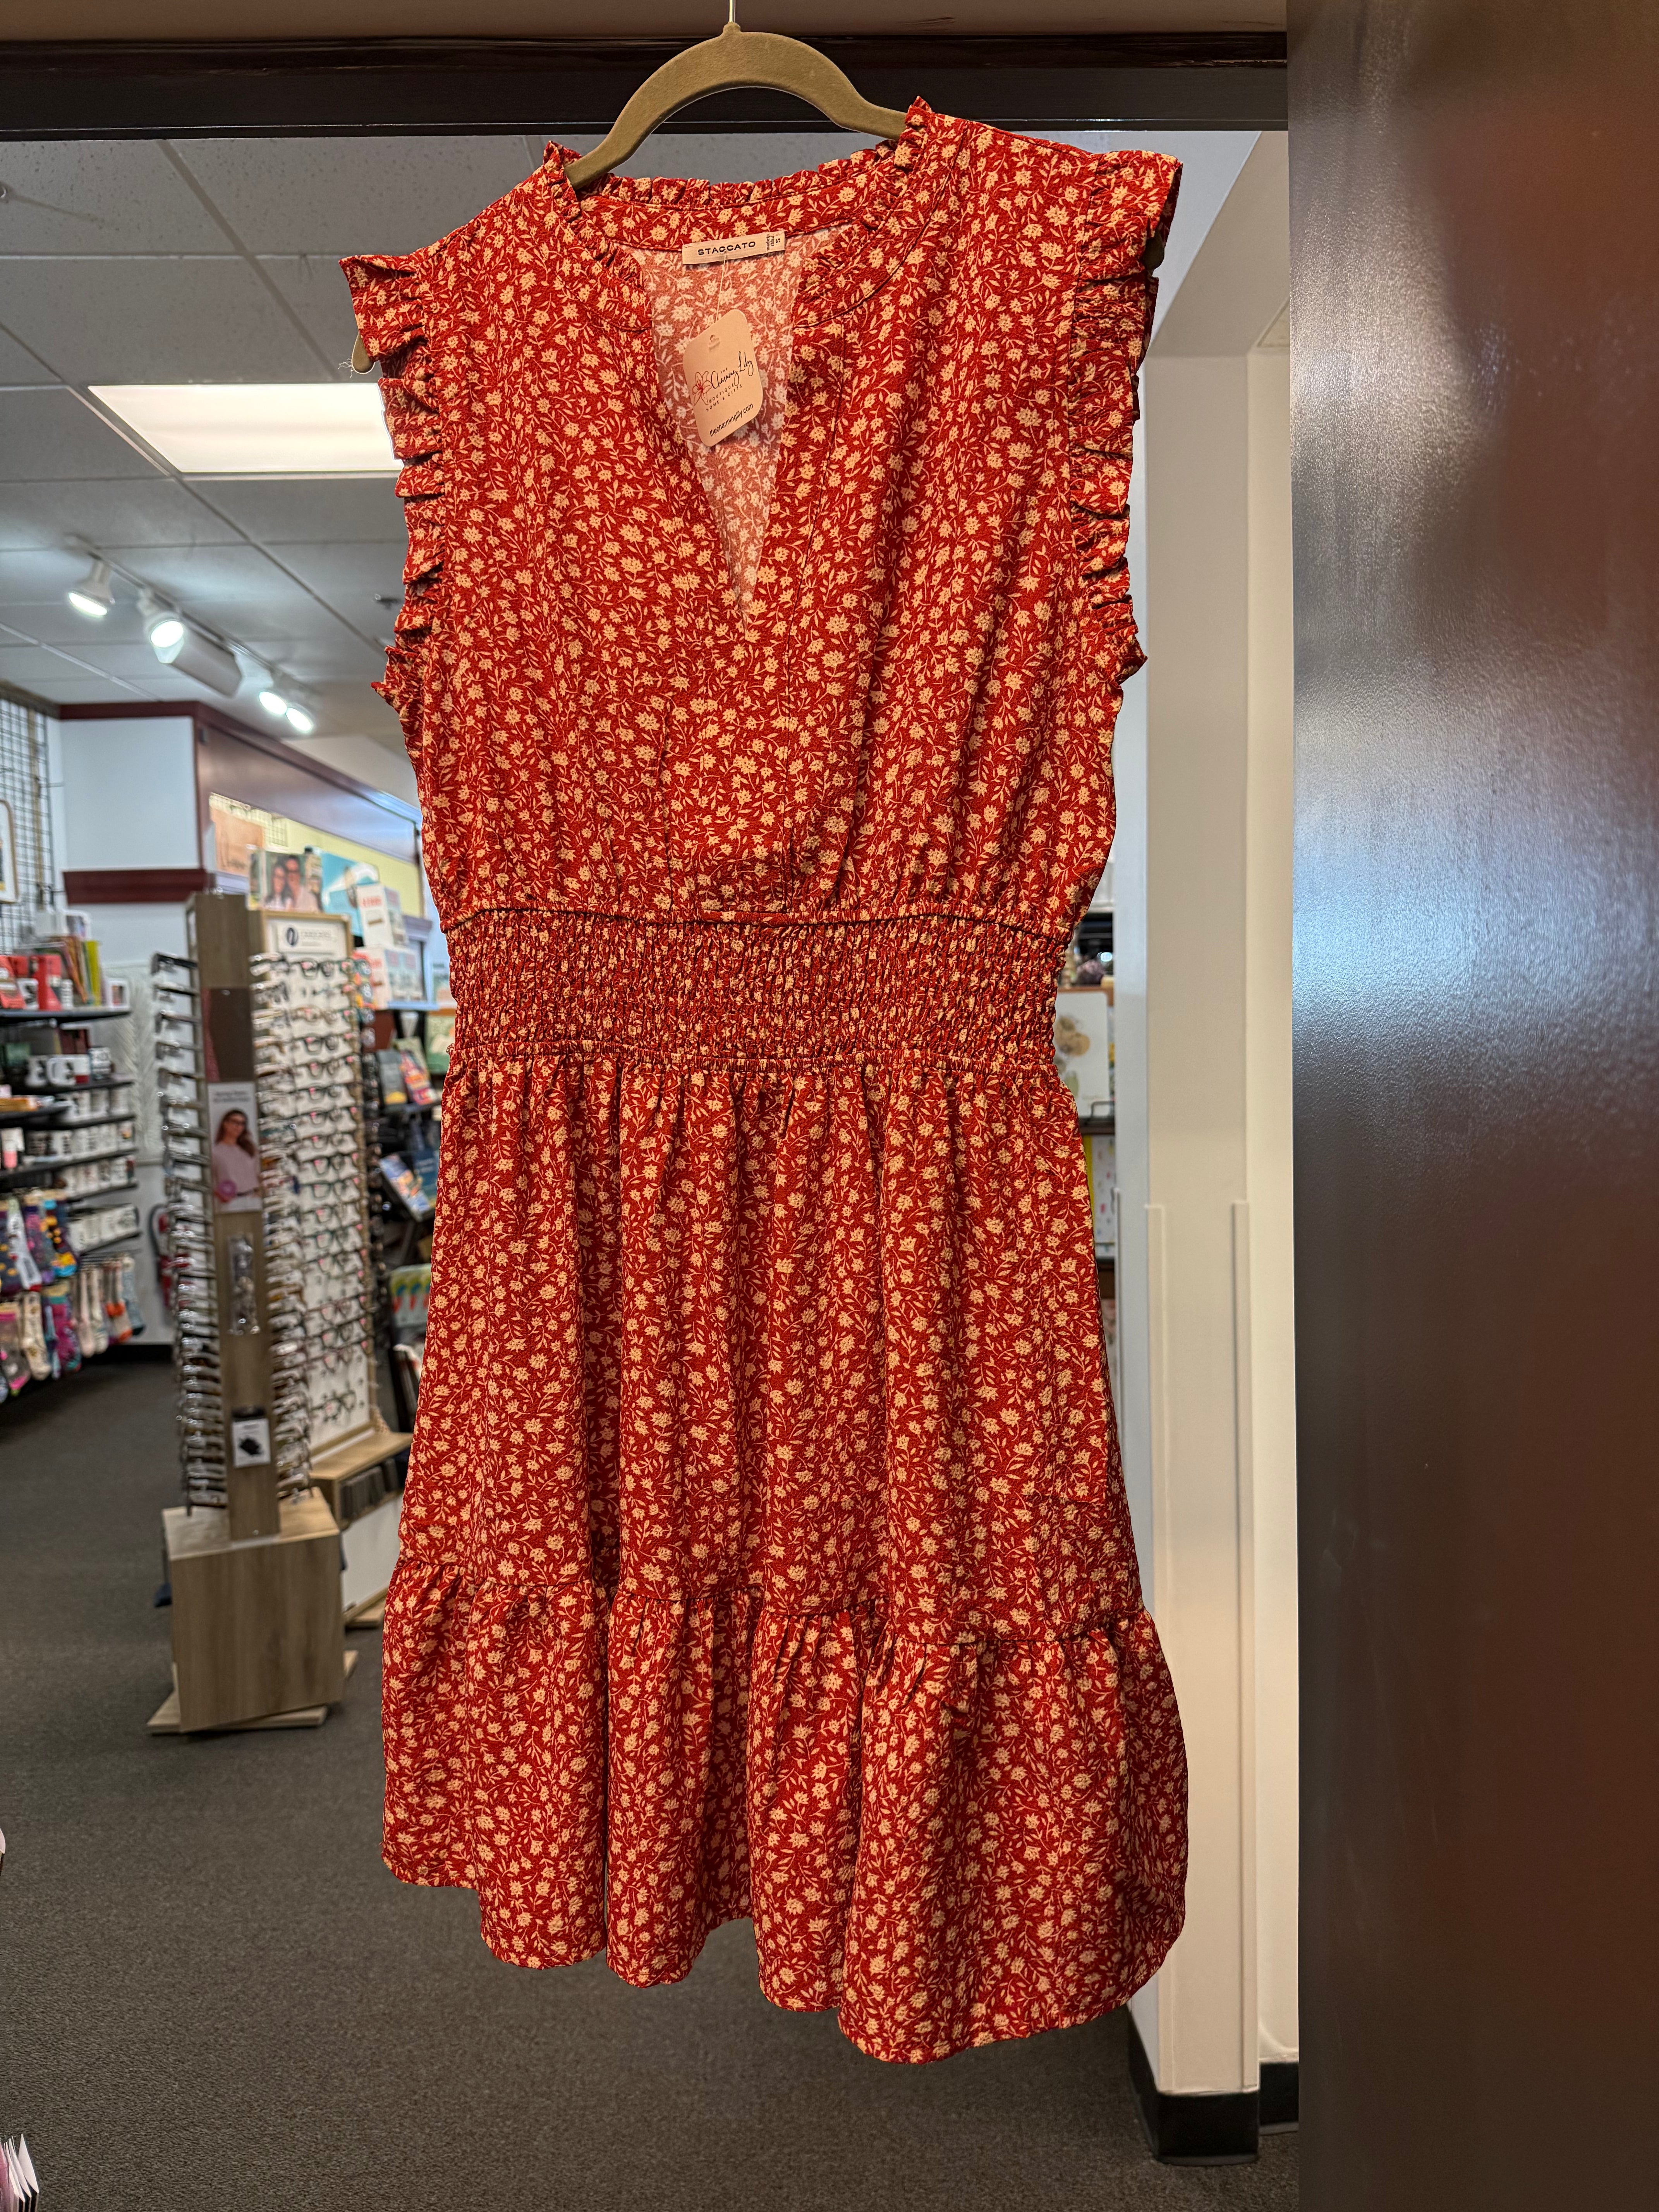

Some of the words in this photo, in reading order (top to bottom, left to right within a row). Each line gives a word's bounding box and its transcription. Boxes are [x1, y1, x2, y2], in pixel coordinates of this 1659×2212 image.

[698, 241, 756, 255] STACCATO
[738, 351, 754, 376] Lily
[706, 400, 719, 412] HOME
[728, 384, 742, 397] GIFTS
[709, 383, 734, 403] BOUTIQUE
[709, 403, 754, 437] thecharminglily.com
